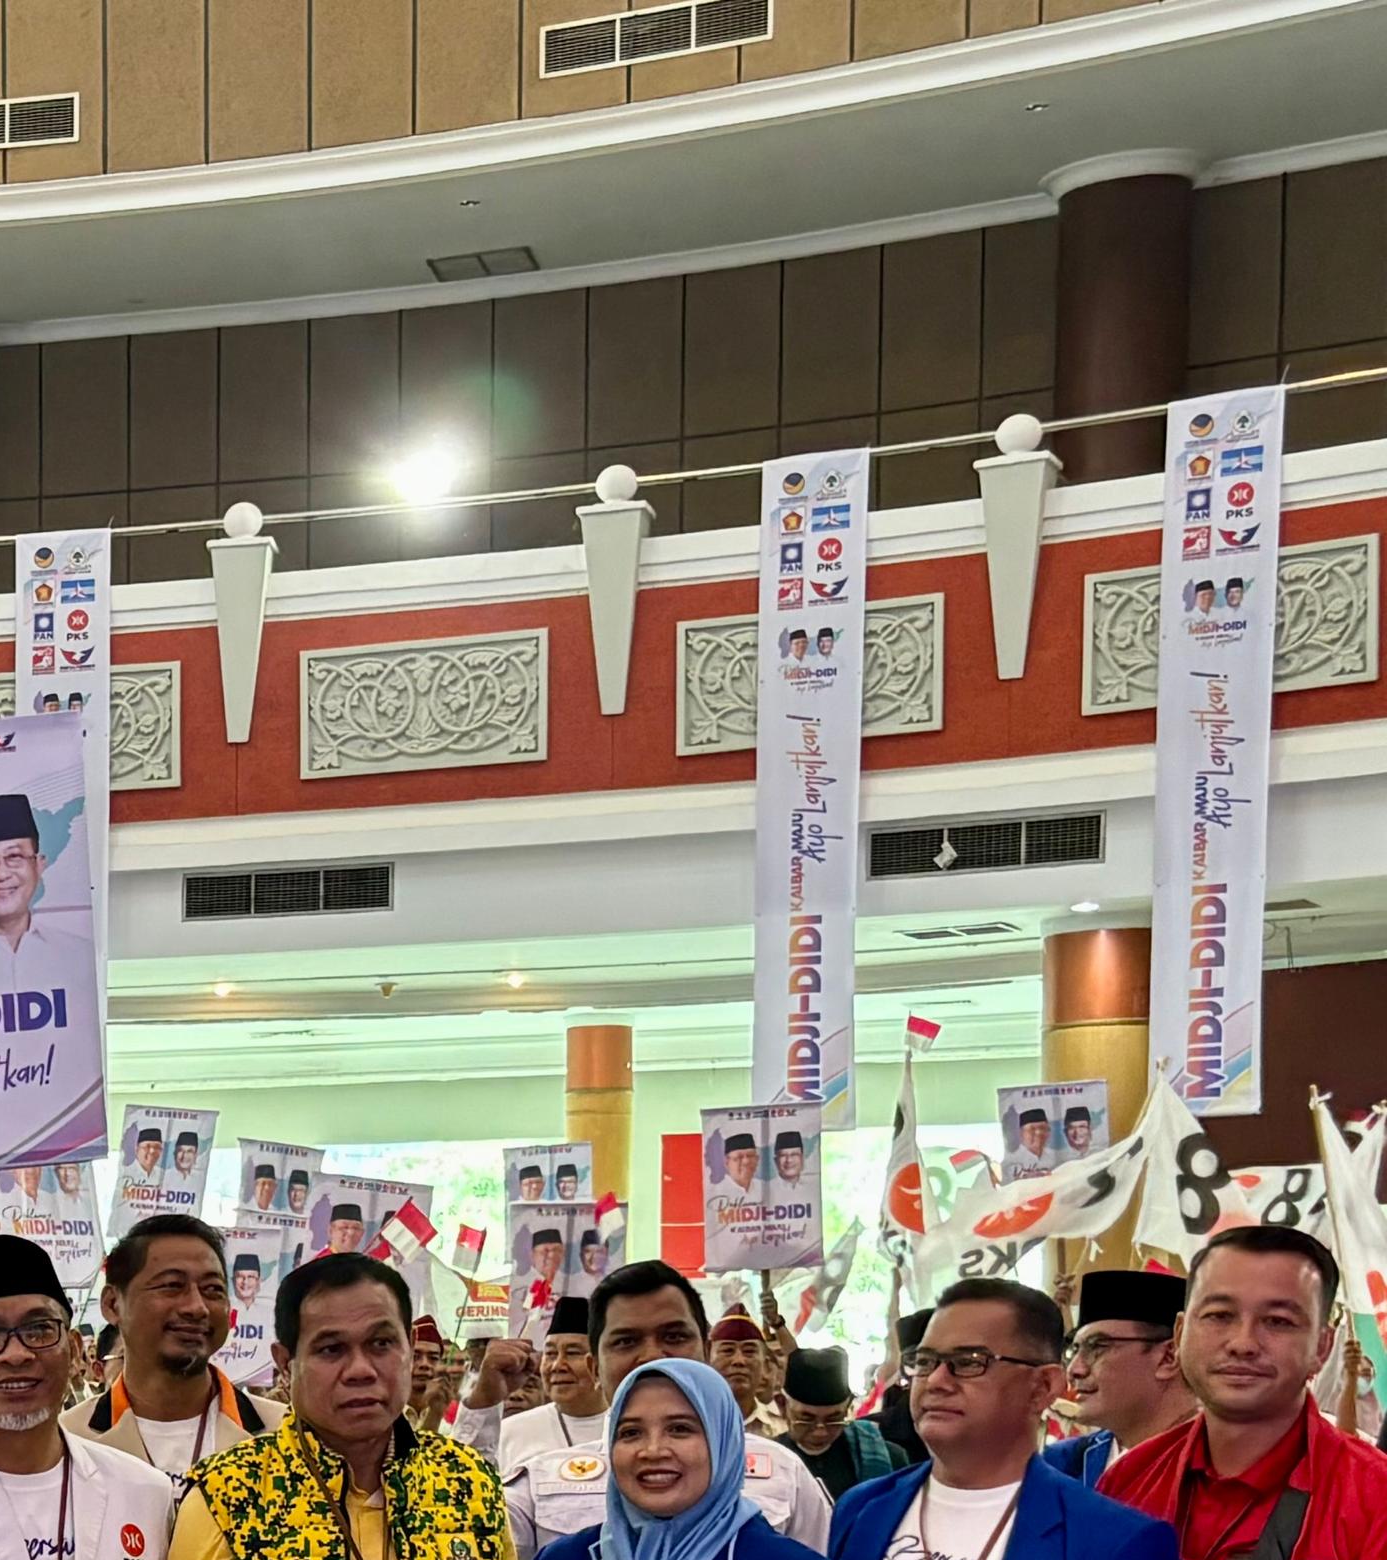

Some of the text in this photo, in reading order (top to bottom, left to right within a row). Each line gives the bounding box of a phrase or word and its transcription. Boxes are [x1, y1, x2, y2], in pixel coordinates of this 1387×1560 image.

[1185, 511, 1210, 521] PAN
[1226, 507, 1253, 520] PKS
[780, 563, 802, 573] PAN
[817, 562, 842, 573] PKS
[33, 632, 54, 640] PAN
[66, 632, 89, 641] PKS
[1189, 672, 1252, 828] Ayo Lanjutkan!
[785, 713, 843, 864] Ayo Lanjutkan!
[1194, 775, 1207, 819] MAJU
[791, 813, 804, 854] MAJU
[1186, 883, 1227, 1098] MIDJI-DIDI
[122, 1187, 196, 1205] MIDJI-DIDI
[718, 1203, 811, 1224] MIDJI-DIDI
